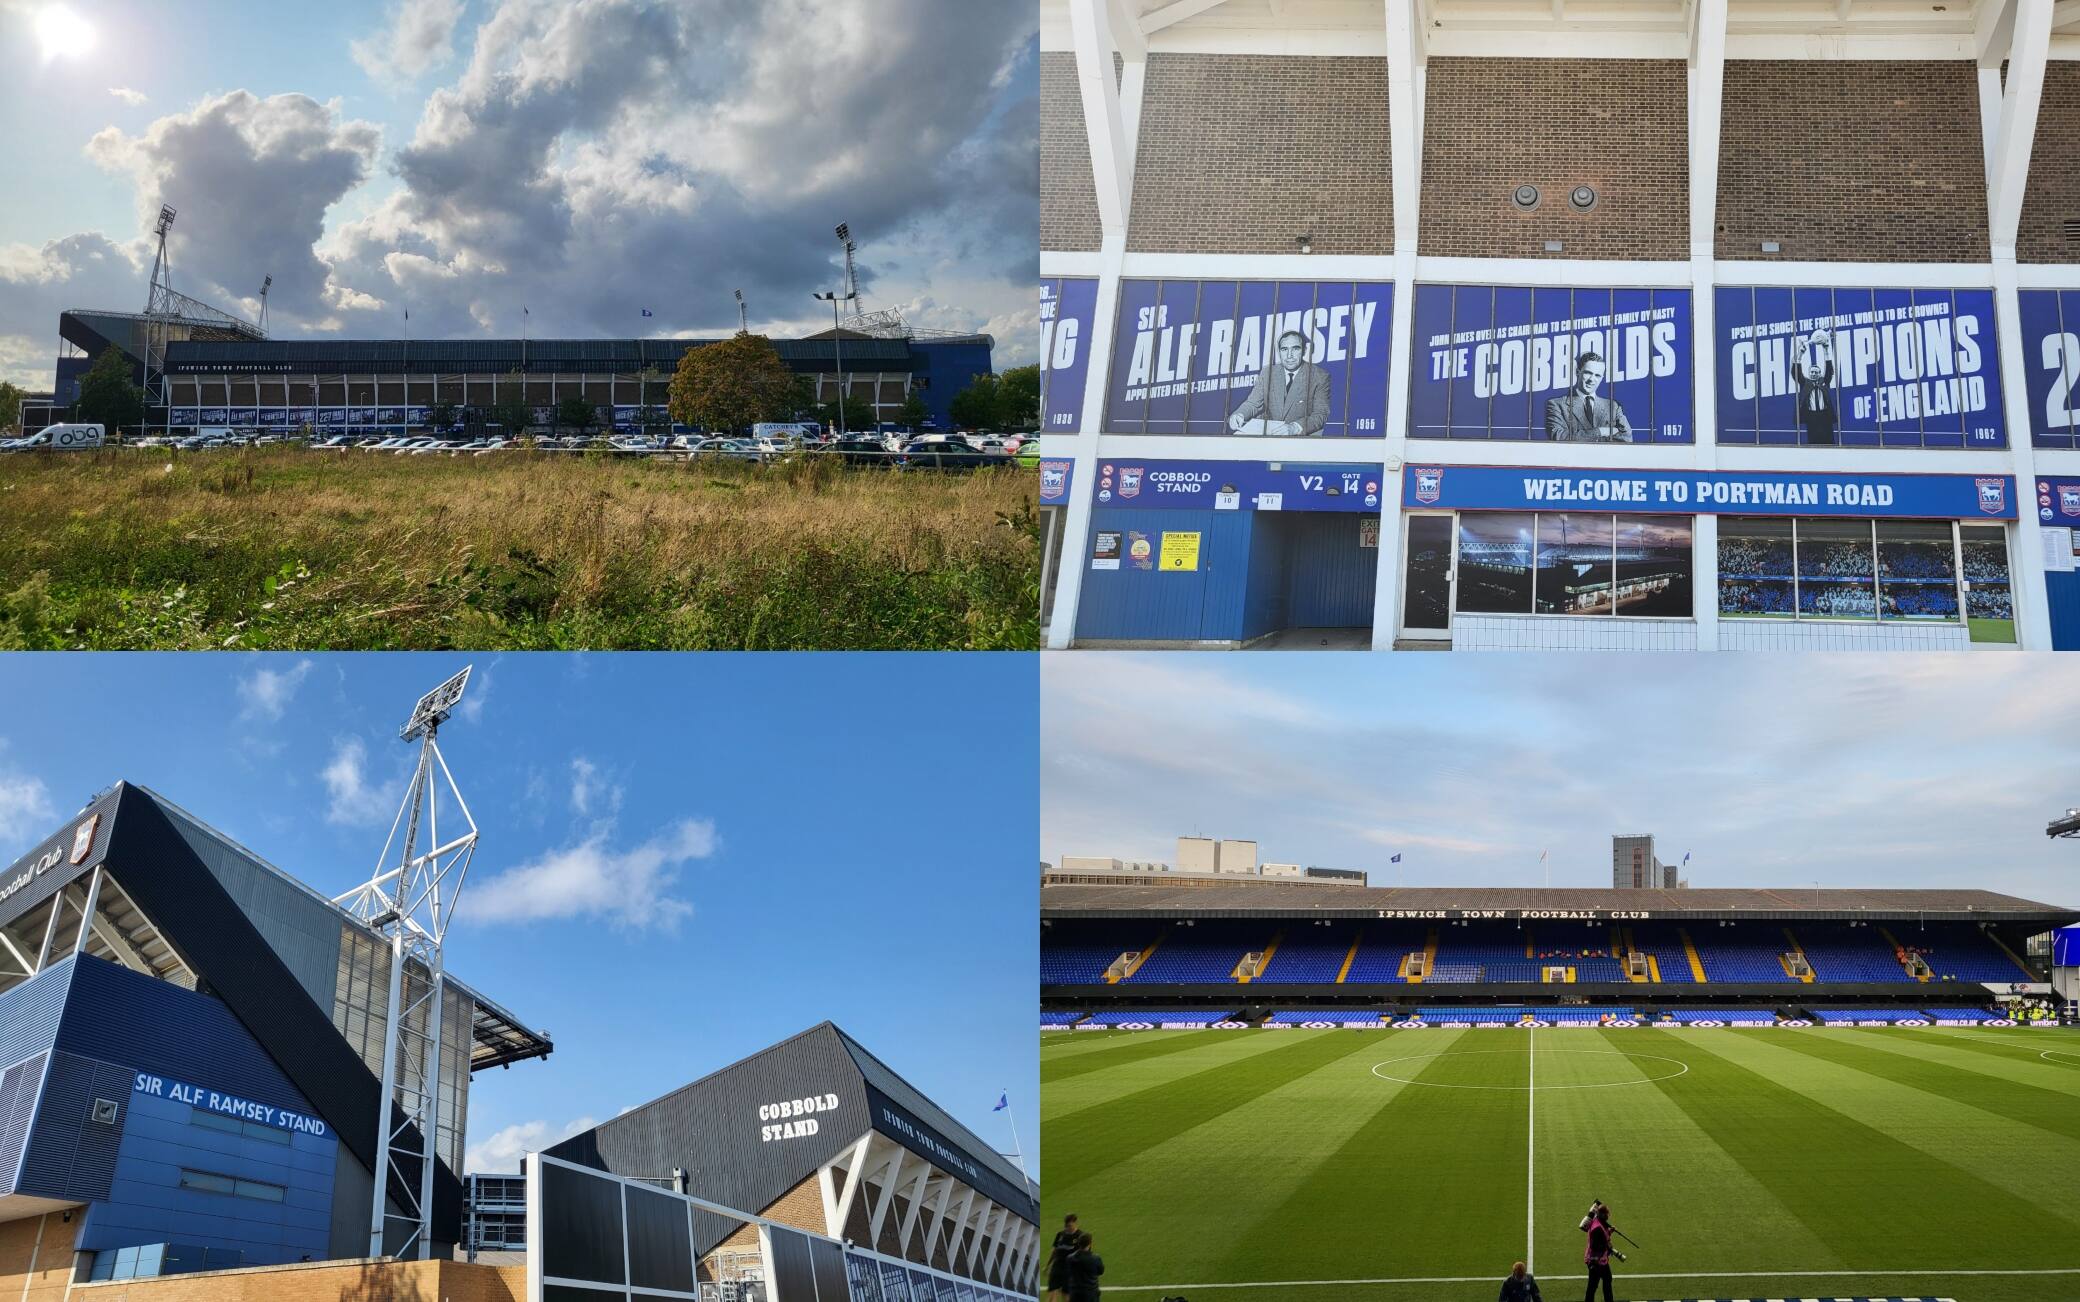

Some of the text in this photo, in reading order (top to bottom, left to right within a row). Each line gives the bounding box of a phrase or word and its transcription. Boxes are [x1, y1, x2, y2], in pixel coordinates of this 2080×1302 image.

[1137, 305, 1168, 330] SIR
[1496, 327, 1507, 339] AS
[1551, 321, 1559, 332] TO
[1614, 311, 1639, 325] FAMILY
[1731, 323, 1768, 339] IPSWCH
[1799, 318, 1813, 331] THE
[1814, 313, 1853, 329] FOOTBALL
[1854, 310, 1884, 324] WORLD
[1885, 308, 1895, 321] TO
[1897, 307, 1907, 319] BE
[1908, 302, 1949, 318] CROWNED
[1127, 301, 1377, 386] ALF RAMSEY
[1431, 347, 1469, 380] THE
[1732, 315, 1982, 400] CHAMPIONS
[1853, 376, 1986, 422] OF ENGLAND
[1356, 418, 1375, 430] 1955
[1663, 424, 1683, 436] 1957
[1975, 428, 1996, 440] 1962
[1149, 472, 1211, 482] COBBOLD
[1157, 483, 1201, 493] STAND
[1300, 475, 1324, 491] V2
[1343, 479, 1359, 494] 14
[1523, 479, 1894, 506] WELCOME TO PORTMAN ROAD
[1365, 534, 1377, 546] 14
[36, 845, 63, 875] Club
[1379, 910, 1447, 918] IPSWICH
[1461, 910, 1506, 918] TOWN
[135, 1074, 325, 1136] SIR ALF RAMSEY STAND
[759, 1093, 839, 1121] COBBOLD
[761, 1118, 819, 1142] STAND
